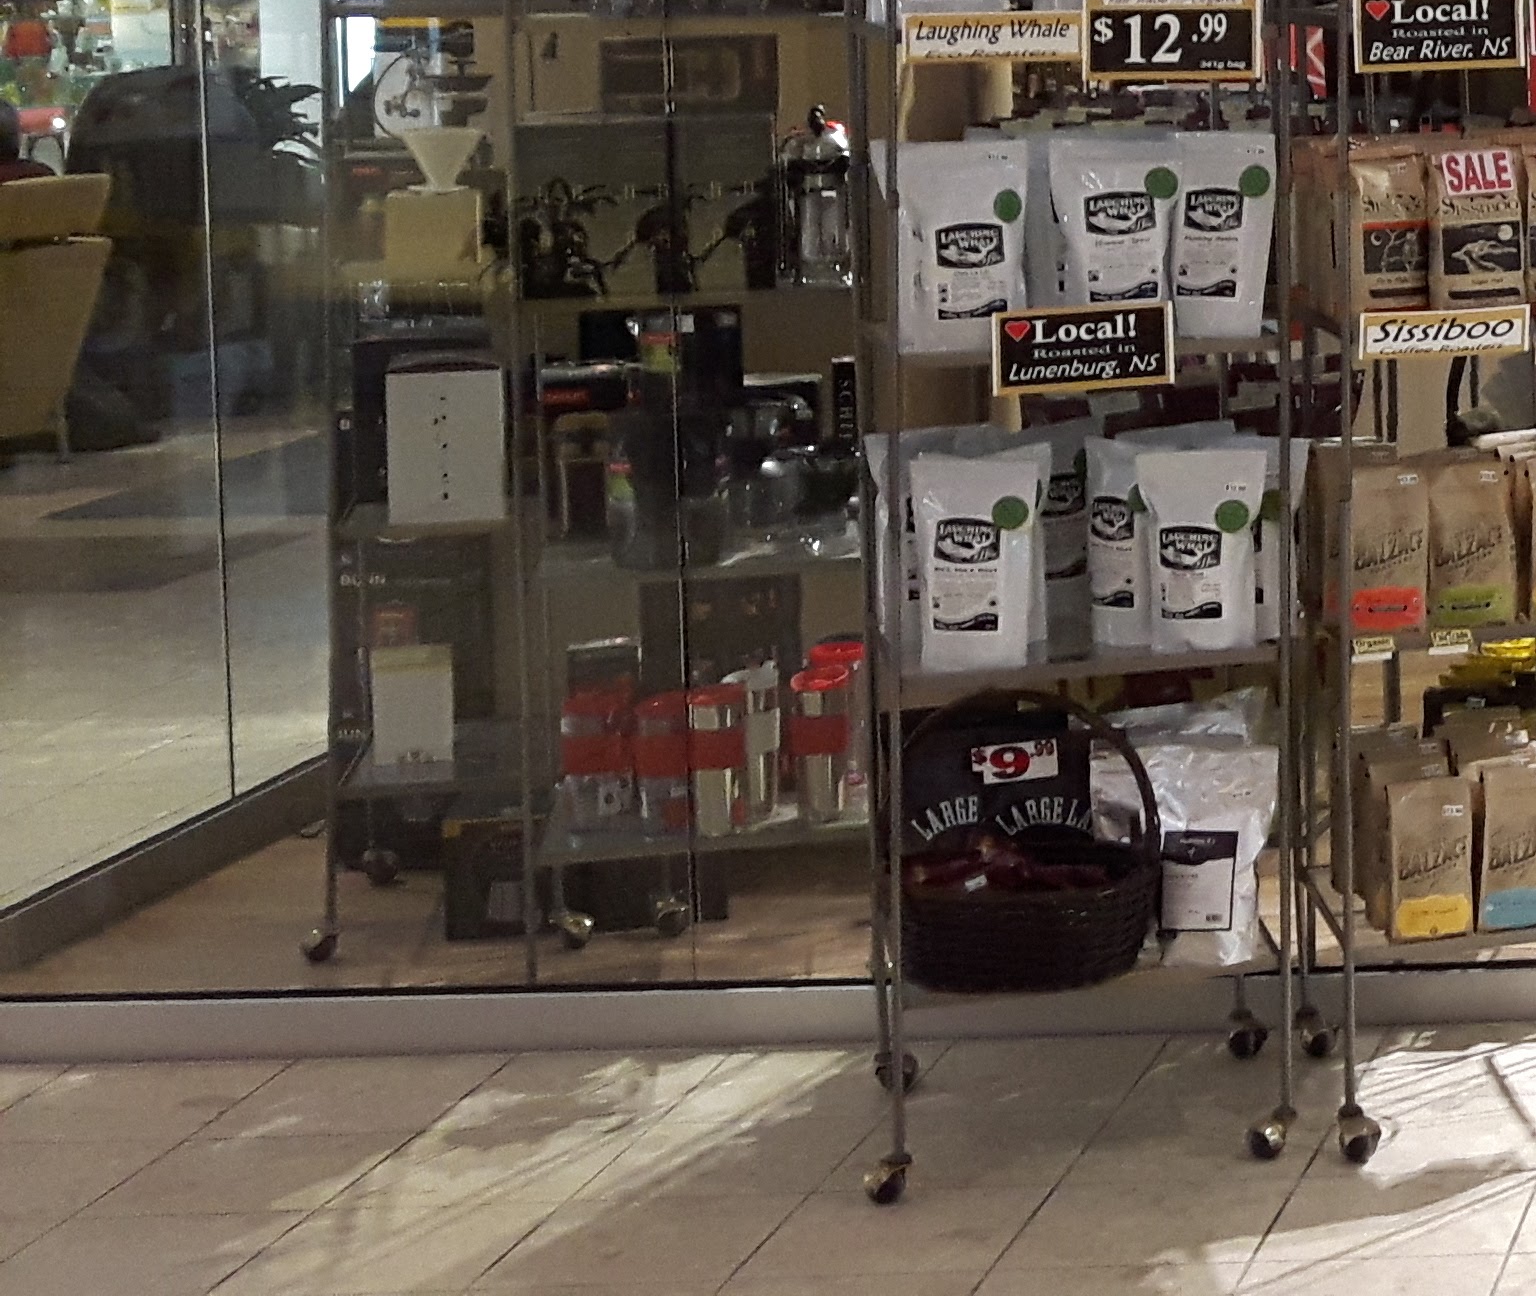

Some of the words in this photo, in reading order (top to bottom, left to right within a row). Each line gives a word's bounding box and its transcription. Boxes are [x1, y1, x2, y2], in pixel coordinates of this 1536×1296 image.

[914, 19, 1002, 46] Laughing
[1009, 18, 1071, 40] Whale
[1092, 12, 1229, 65] $12.99
[1391, 25, 1468, 39] Roasted
[1472, 24, 1489, 37] in
[1368, 41, 1416, 62] Bear
[1481, 35, 1511, 58] NS
[1445, 151, 1513, 194] SALE
[1031, 313, 1138, 344] Local!
[1372, 318, 1515, 344] Sissiboo
[1032, 344, 1112, 359] Roasted
[1115, 342, 1136, 355] in
[1129, 353, 1161, 373] NS
[911, 794, 979, 842] LARGE
[994, 795, 1064, 837] LARGE
